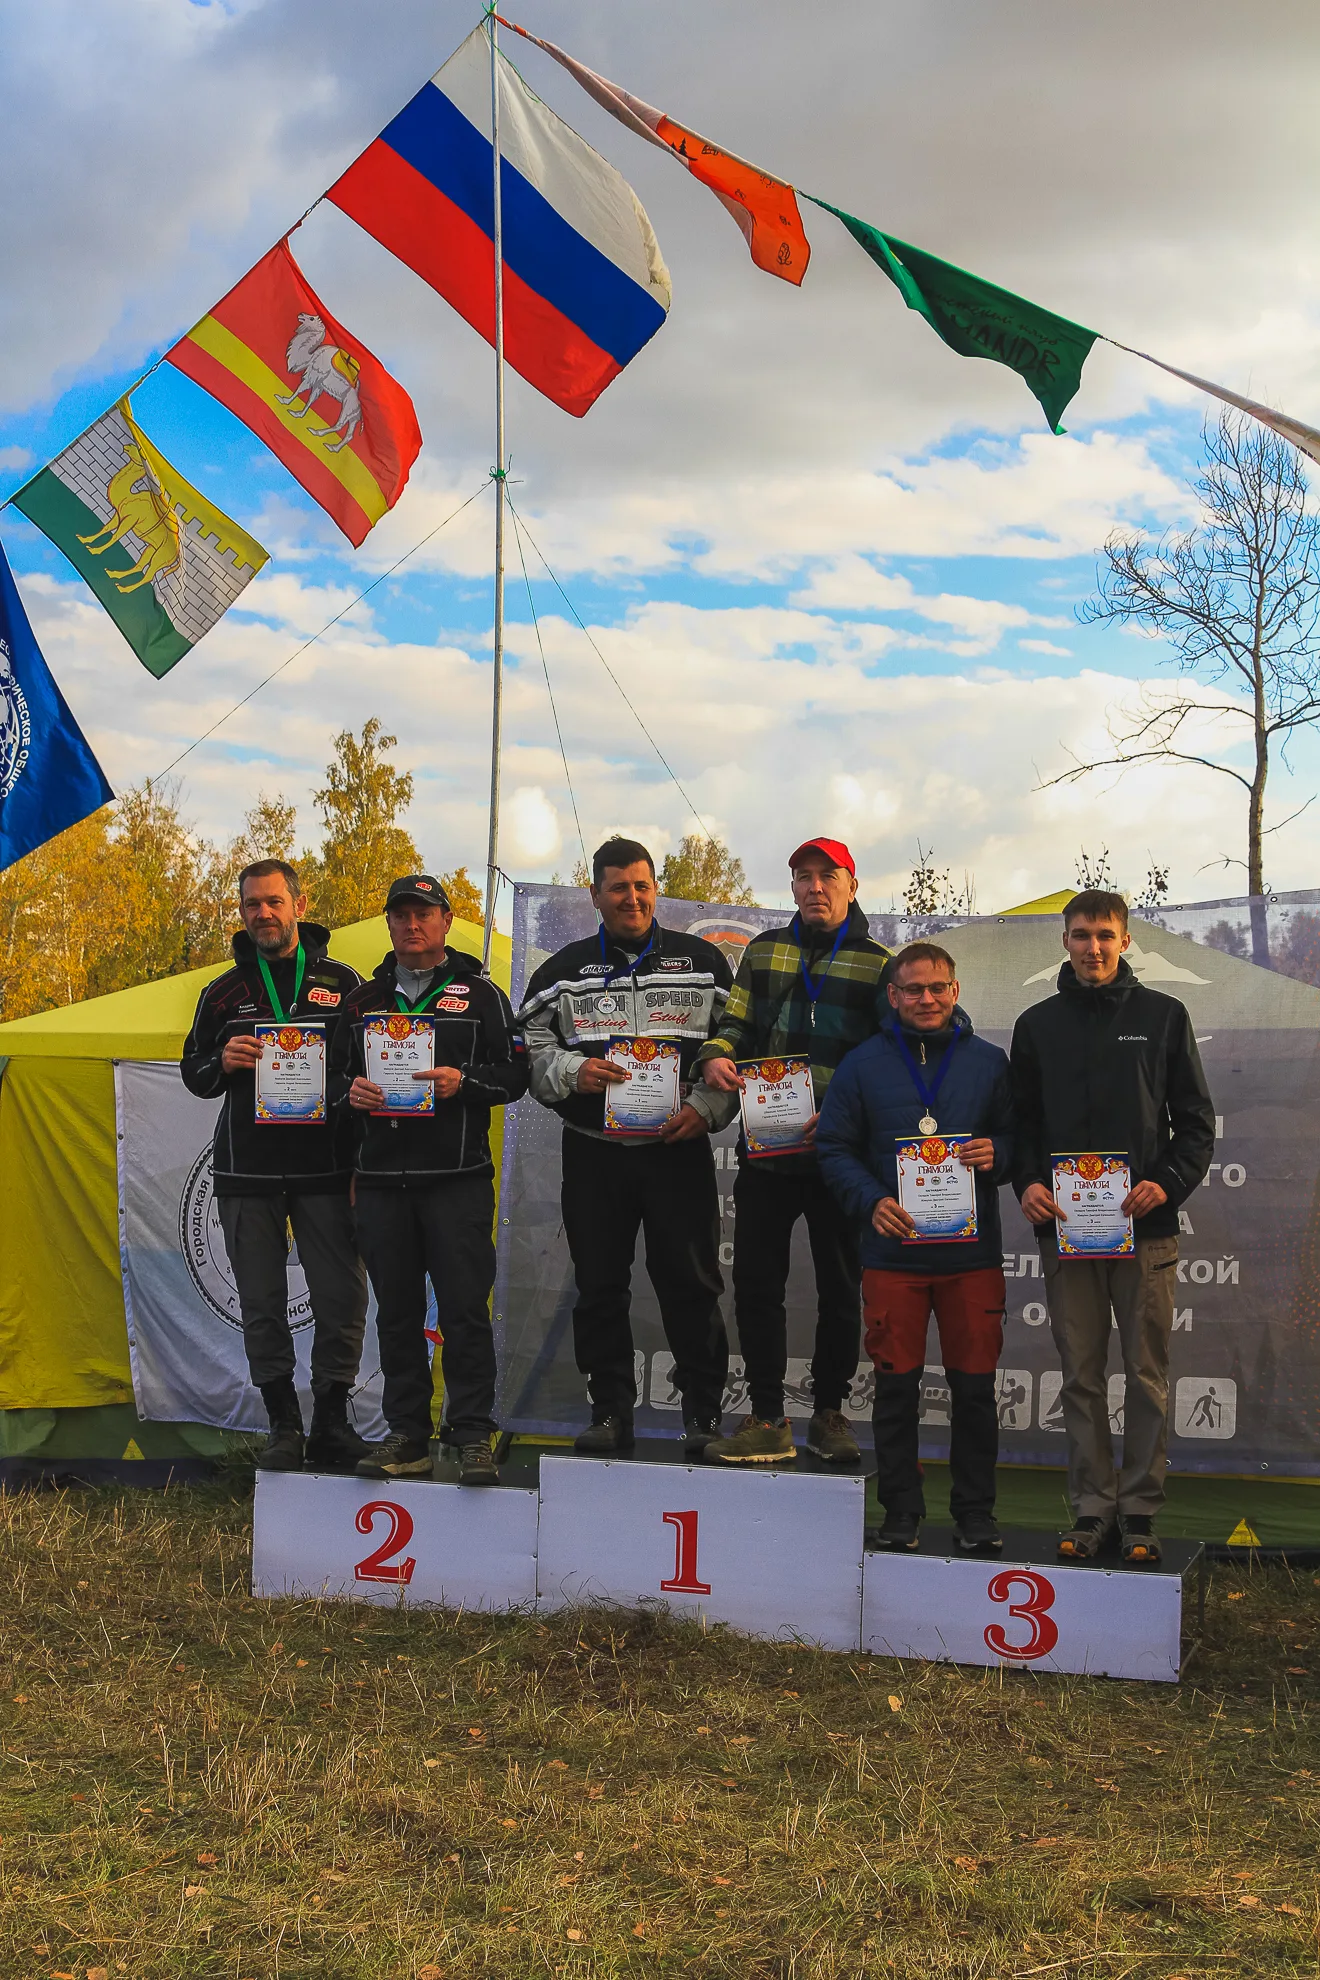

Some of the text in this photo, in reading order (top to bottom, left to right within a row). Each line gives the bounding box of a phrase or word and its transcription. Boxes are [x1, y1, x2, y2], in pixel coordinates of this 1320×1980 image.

[310, 993, 339, 1004] RED
[438, 1000, 467, 1010] RED
[644, 991, 704, 1008] SPEED
[573, 1012, 692, 1029] Racing Stuff
[192, 1179, 210, 1267] Городская
[355, 1501, 1057, 1659] 2 1 3
